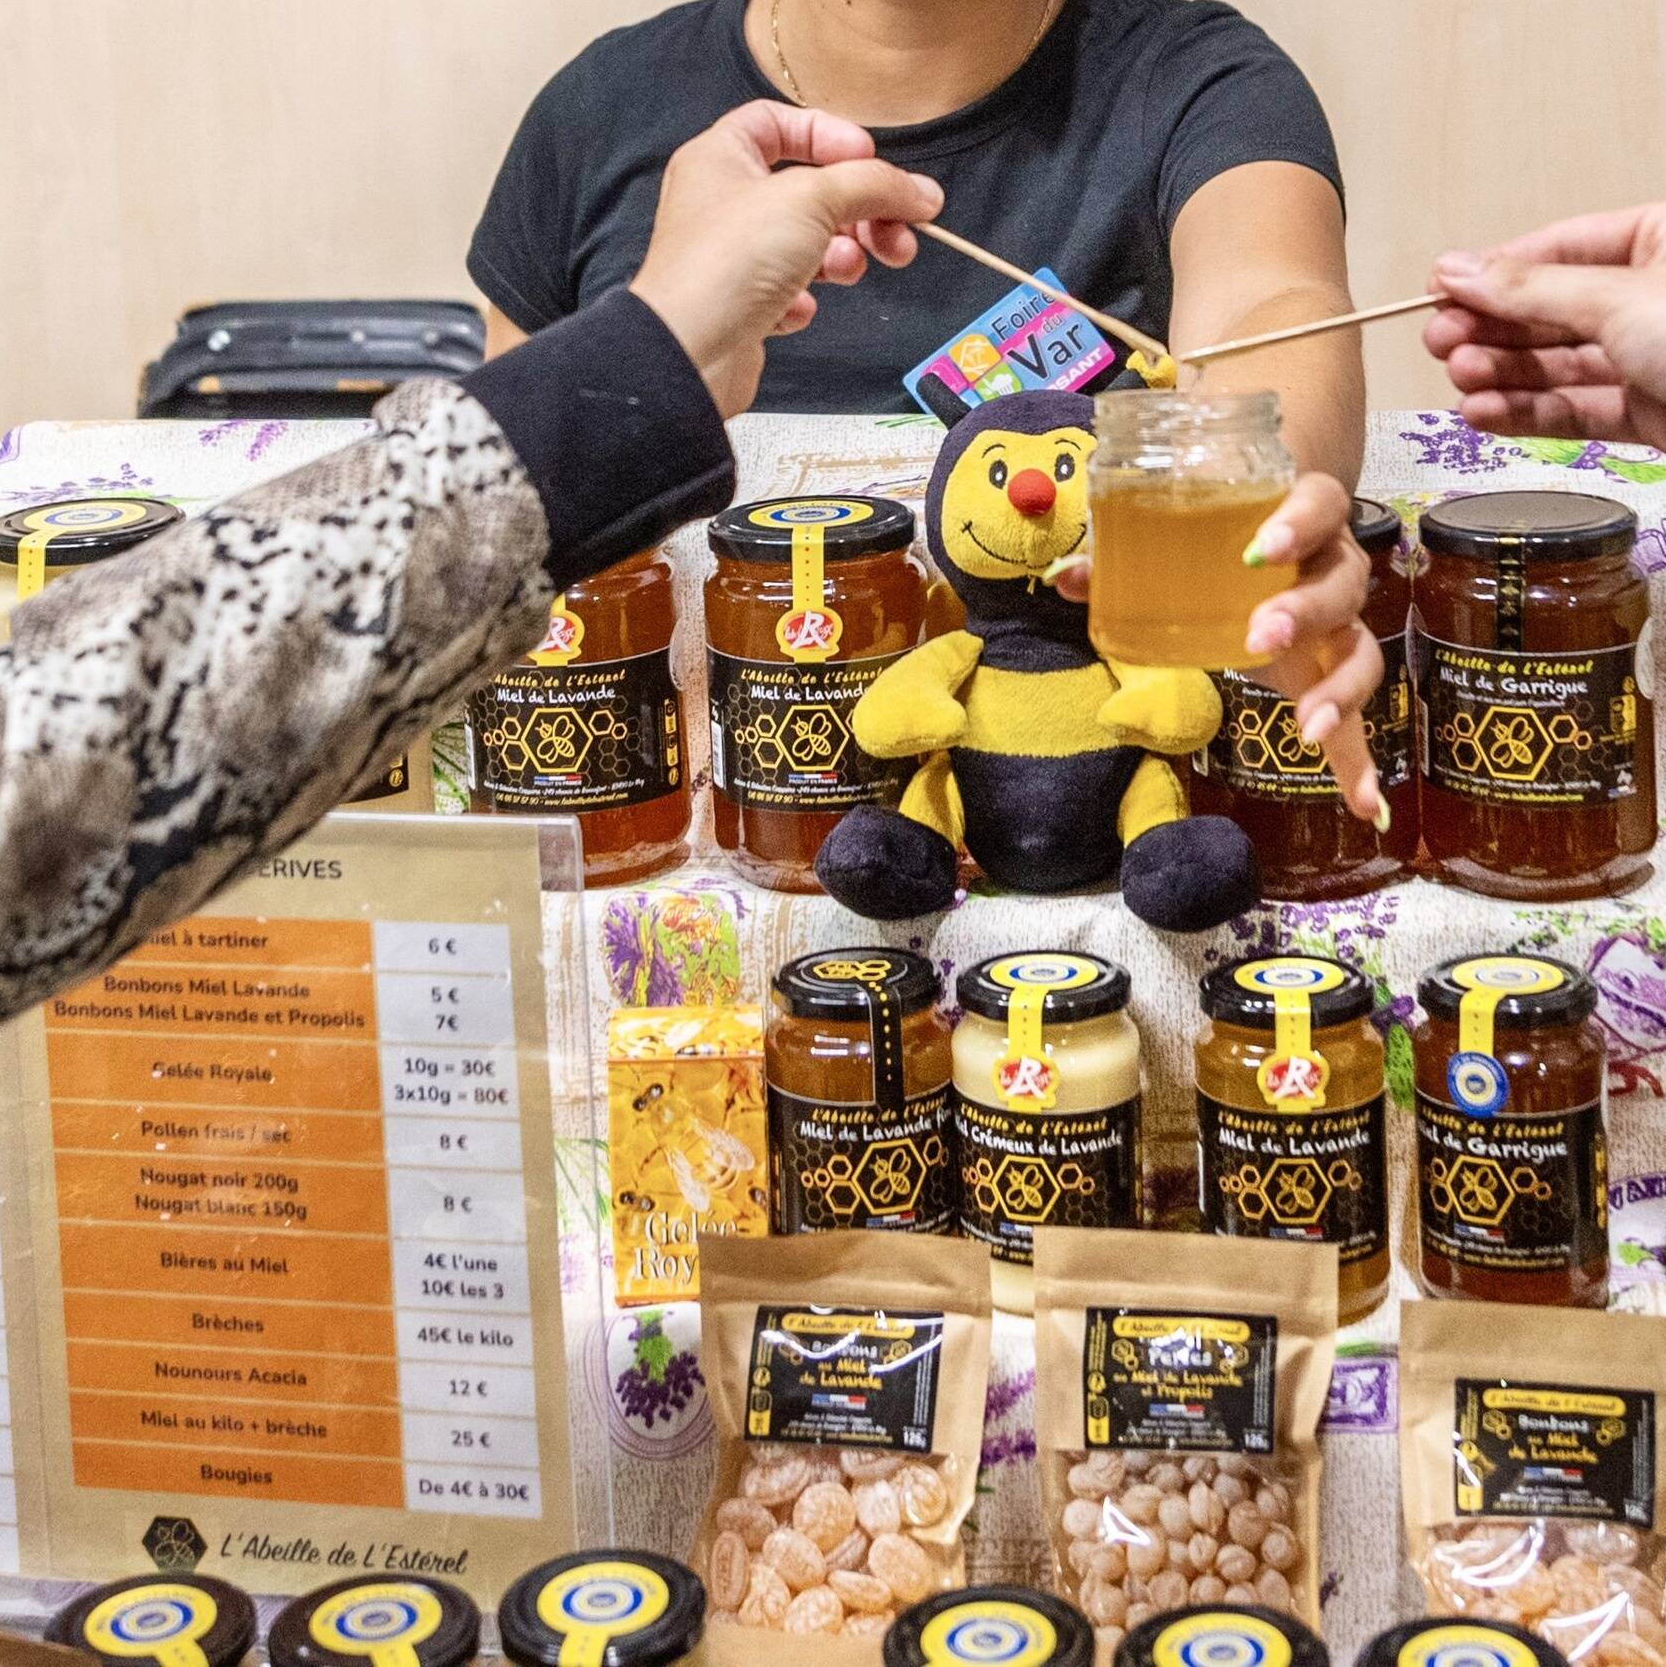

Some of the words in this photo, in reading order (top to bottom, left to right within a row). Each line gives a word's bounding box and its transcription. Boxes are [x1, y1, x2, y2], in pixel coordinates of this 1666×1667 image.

[990, 292, 1055, 342] Foire
[1043, 314, 1064, 333] du
[1007, 322, 1082, 380] Var
[493, 674, 539, 687] Abeille
[1440, 667, 1470, 687] Miel
[1501, 677, 1588, 701] Garrigue
[497, 688, 525, 704] Miel
[530, 690, 545, 704] de
[548, 685, 616, 704] Lavande
[750, 686, 780, 701] Miel
[784, 686, 802, 701] de
[253, 857, 342, 880] ERIVES
[149, 931, 176, 946] iel
[198, 931, 269, 948] tartiner
[428, 938, 440, 953] 6
[444, 940, 457, 955] €
[104, 976, 183, 996] Bonbons
[189, 978, 226, 996] Miel
[233, 980, 310, 999] Lavande
[445, 989, 458, 1004] €
[54, 1001, 132, 1021] Bonbons
[138, 1003, 176, 1021] Miel
[183, 1005, 258, 1024] Lavande
[264, 1009, 283, 1024] et
[289, 1008, 365, 1030] Propolis
[435, 1015, 459, 1031] 7€
[152, 1061, 205, 1081] Gelée
[210, 1064, 272, 1086] Royale
[404, 1058, 437, 1077] 10g
[462, 1058, 496, 1076] 30€
[394, 1085, 451, 1105] 3x10g
[475, 1087, 509, 1104] 80€
[141, 1121, 198, 1139] Pollen
[800, 1120, 833, 1140] Miel
[838, 1126, 858, 1142] de
[863, 1114, 932, 1142] Lavande
[440, 1135, 450, 1149] 8
[456, 1136, 468, 1150] €
[971, 1125, 1034, 1154] Crémeux
[1039, 1139, 1057, 1155] de
[1061, 1128, 1123, 1156] Lavande
[1218, 1128, 1255, 1152] Miel
[1260, 1137, 1283, 1154] de
[1289, 1127, 1370, 1156] Lavande
[1467, 1137, 1568, 1163] Garrigue
[140, 1168, 205, 1189] Nougat
[213, 1171, 248, 1187] noir
[254, 1173, 299, 1194] 200g
[135, 1194, 200, 1215] Nougat
[207, 1197, 256, 1215] blanc
[262, 1198, 308, 1221] 150g
[444, 1197, 454, 1211] 8
[459, 1198, 471, 1213] €
[160, 1251, 217, 1271] Bières
[223, 1257, 244, 1271] au
[250, 1256, 288, 1274] Miel
[424, 1254, 447, 1270] 4€
[453, 1255, 498, 1272] l'une
[635, 1247, 700, 1285] Roy
[421, 1280, 455, 1297] 10€
[461, 1282, 487, 1298] les
[493, 1283, 504, 1299] 3
[192, 1312, 264, 1333] Brèches
[417, 1328, 451, 1344] 45€
[457, 1330, 475, 1344] le
[480, 1331, 513, 1347] kilo
[154, 1361, 242, 1383] Nounours
[249, 1367, 307, 1386] Acacia
[450, 1380, 469, 1395] 12
[475, 1382, 488, 1397] €
[141, 1411, 178, 1430] Miel
[185, 1416, 206, 1430] au
[212, 1414, 244, 1432] kilo
[267, 1417, 327, 1439] brèche
[451, 1431, 472, 1447] 25
[477, 1432, 490, 1448] €
[200, 1463, 273, 1485] Bougies
[419, 1479, 444, 1495] De
[450, 1481, 473, 1497] 4€
[479, 1480, 489, 1497] à
[495, 1482, 529, 1500] 30€
[220, 1533, 321, 1565] L'Abeille
[327, 1537, 357, 1566] de
[363, 1540, 469, 1574] L'Estérel
